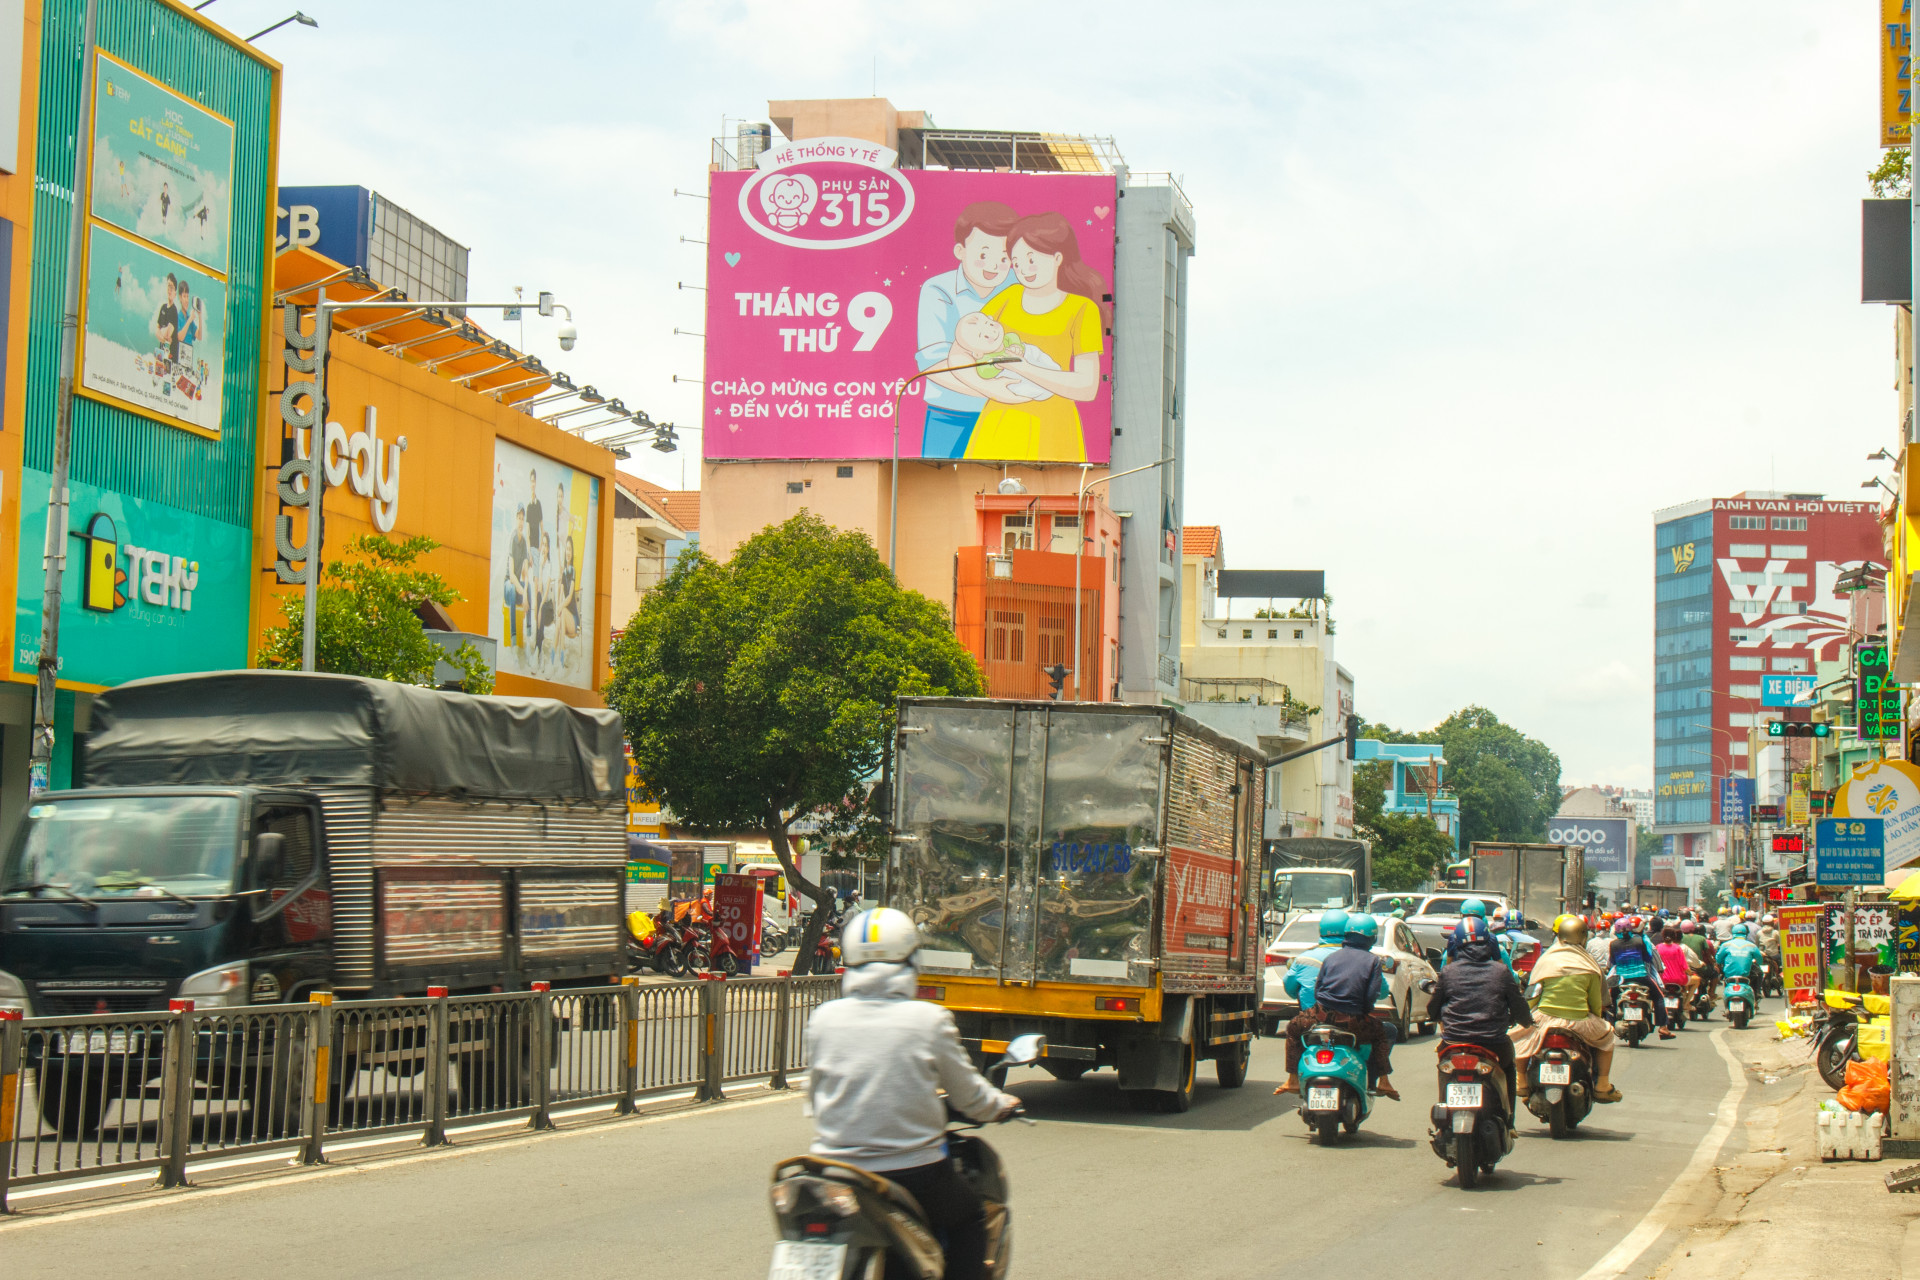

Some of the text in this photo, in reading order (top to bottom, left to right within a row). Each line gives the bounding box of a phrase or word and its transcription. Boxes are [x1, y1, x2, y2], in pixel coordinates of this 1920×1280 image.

[776, 141, 881, 164] HỆ THỐNG Y TẾ
[822, 176, 890, 193] PHỤ SẢN
[819, 192, 890, 227] 315
[734, 286, 840, 317] THÁNG
[779, 291, 893, 353] THỨ 9
[710, 377, 921, 396] CHÀO MỪNG CON YÊU
[729, 397, 896, 418] ĐẾN VỚI THẾ GIỚ
[1714, 500, 1752, 510] ANH
[1827, 501, 1865, 517] VIỆT
[1869, 503, 1880, 514] M
[1768, 679, 1782, 695] XE
[1658, 782, 1672, 799] HỘI
[1673, 781, 1691, 798] VIỆT
[1549, 825, 1607, 844] odoo
[1477, 849, 1503, 857] ISUZU
[1186, 865, 1239, 910] LALAMOVE
[720, 905, 741, 920] 30
[1869, 913, 1883, 926] ÉP
[1857, 927, 1872, 939] TRÀ
[1786, 953, 1800, 968] IN
[1793, 972, 1819, 987] SCA
